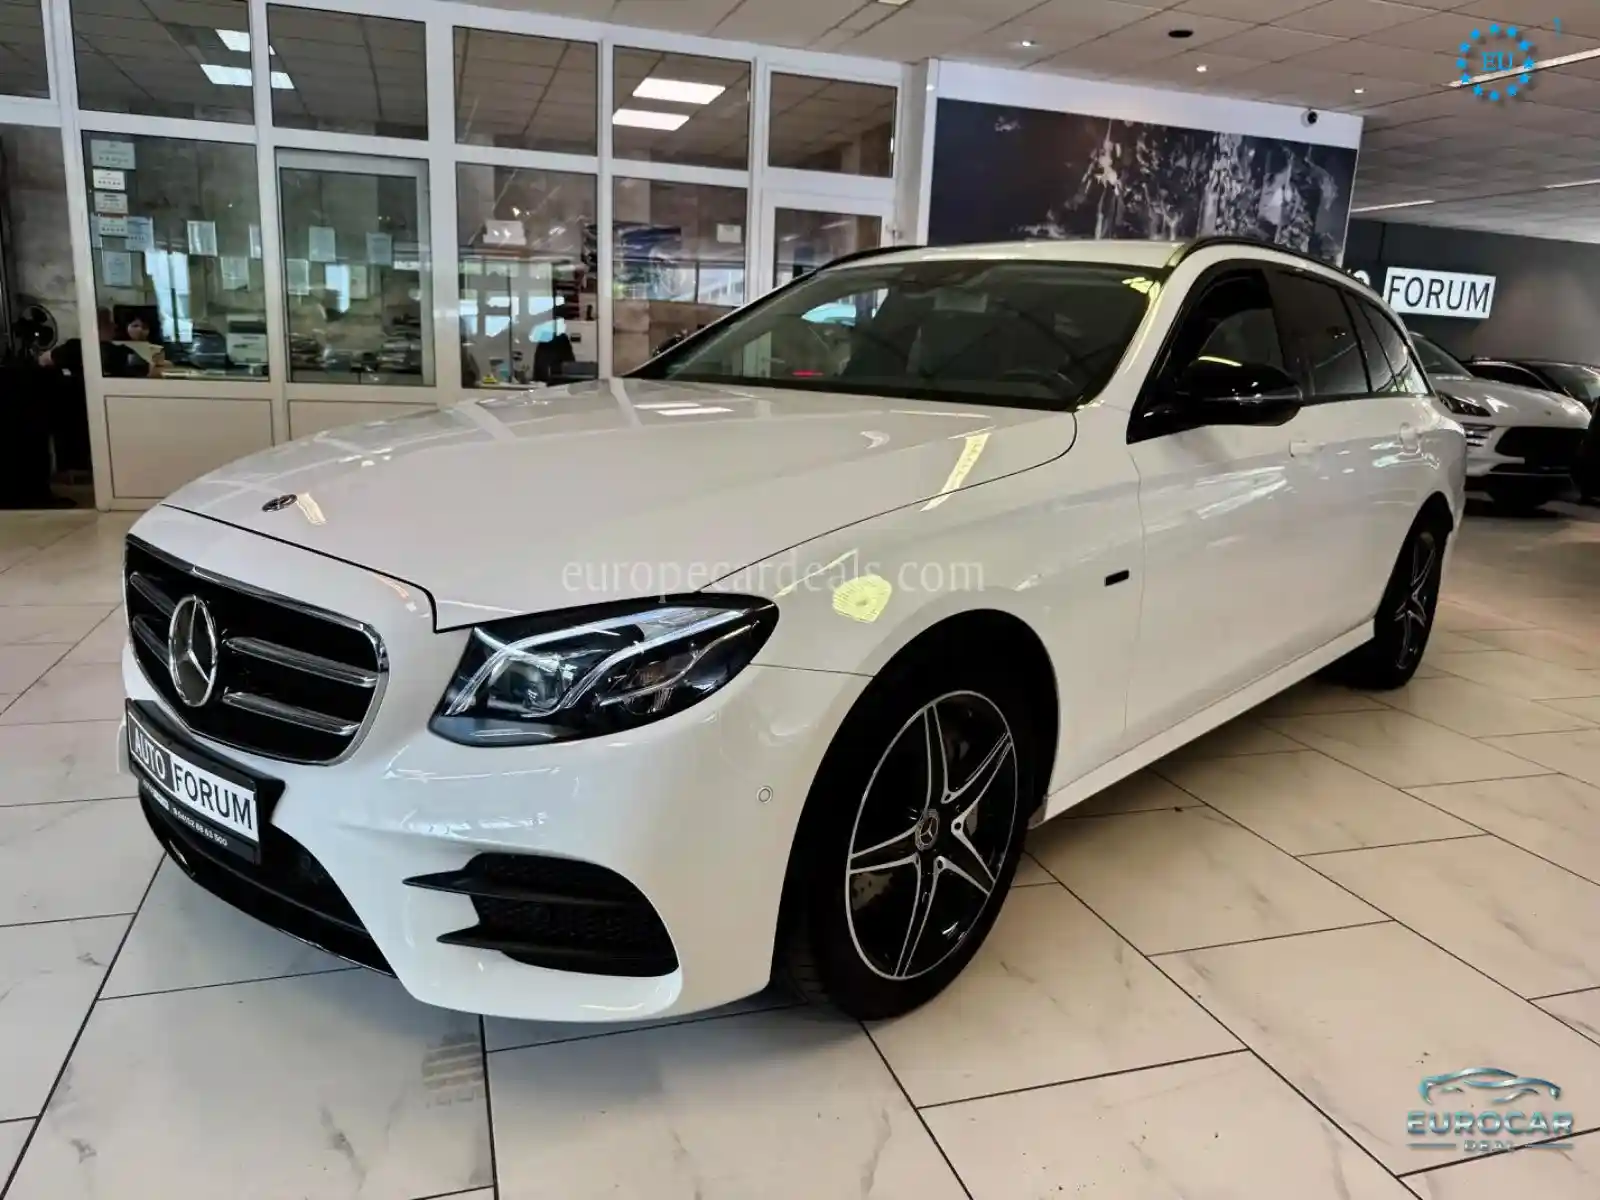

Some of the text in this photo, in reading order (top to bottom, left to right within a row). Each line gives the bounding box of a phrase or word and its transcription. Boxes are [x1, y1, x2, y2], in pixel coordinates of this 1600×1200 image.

[1387, 275, 1491, 314] FORUM
[133, 727, 167, 781] AUTO
[174, 763, 254, 831] FORUM
